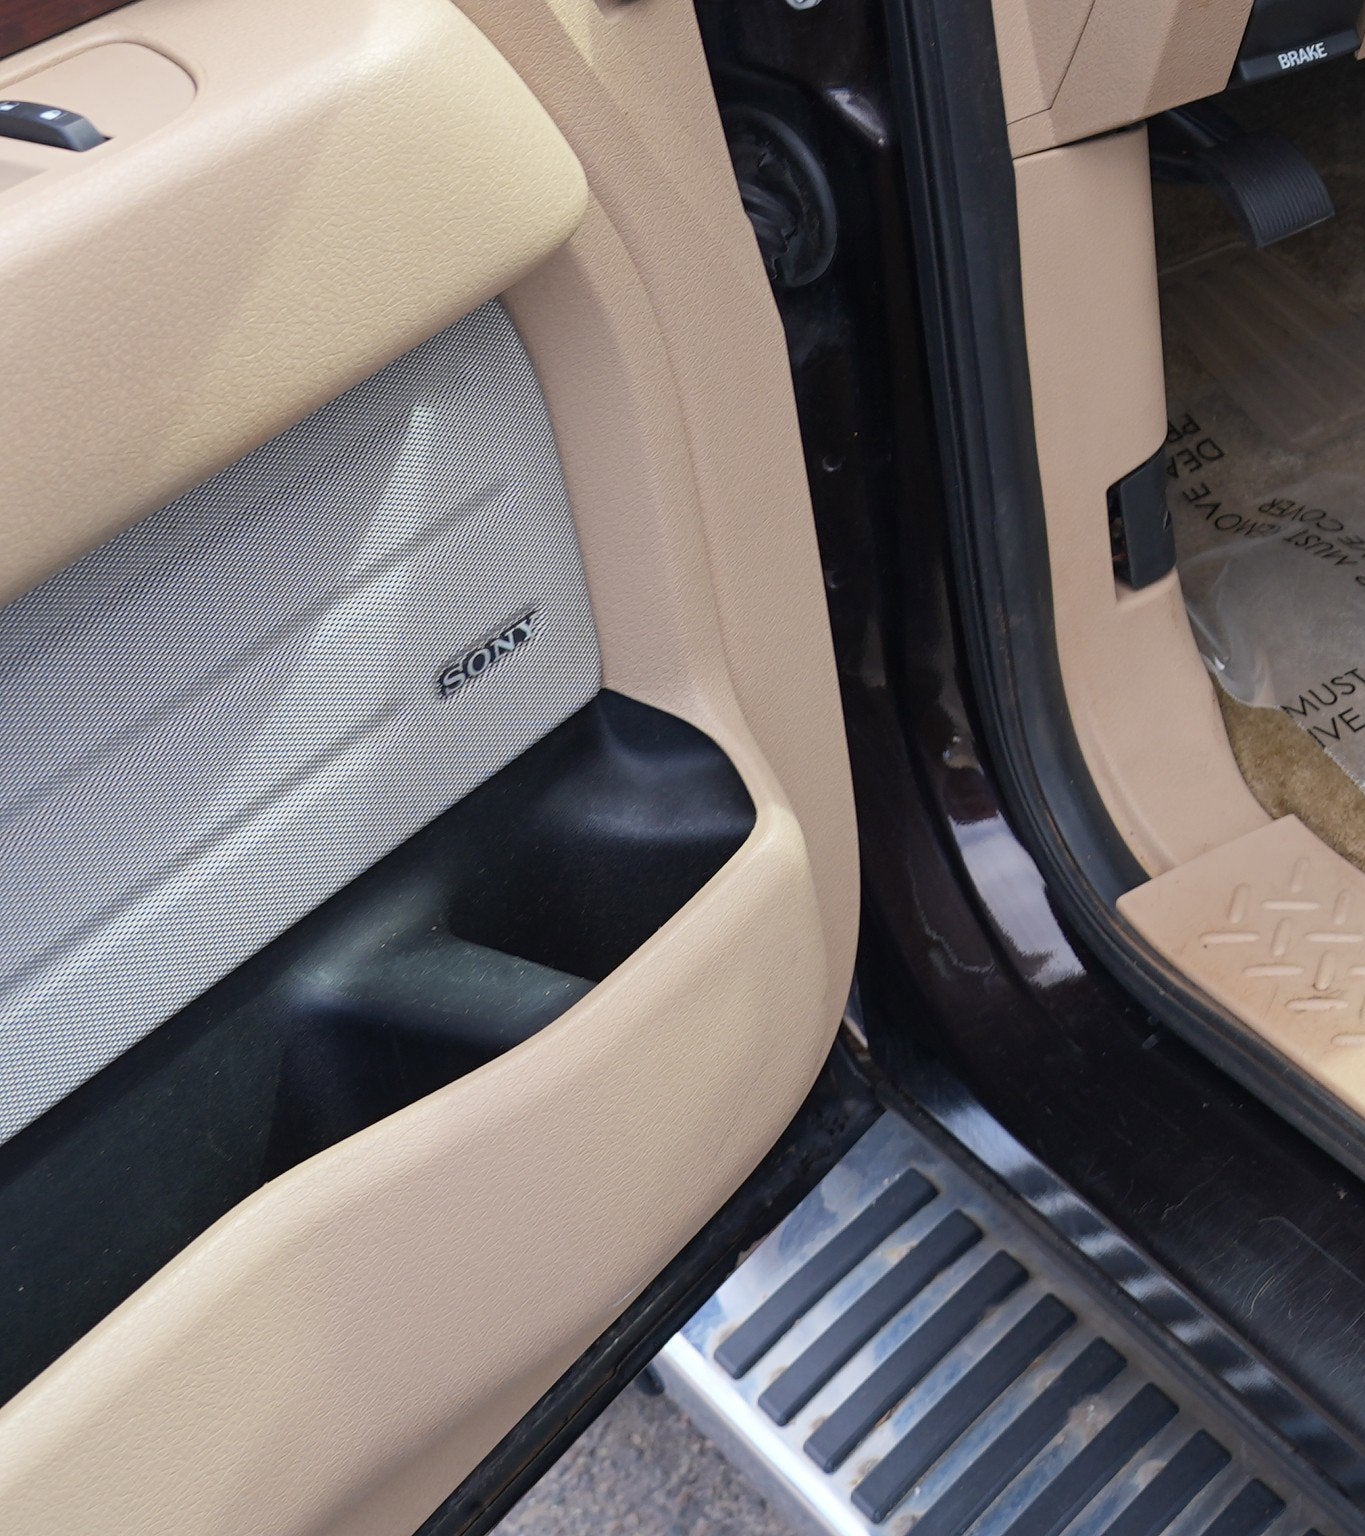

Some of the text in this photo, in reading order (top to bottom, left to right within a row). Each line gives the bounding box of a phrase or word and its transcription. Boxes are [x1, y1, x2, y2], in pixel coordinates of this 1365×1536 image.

[1277, 42, 1329, 70] BRAKE
[1257, 497, 1345, 533] COVER
[1282, 529, 1359, 567] MUST
[442, 612, 537, 695] SONY
